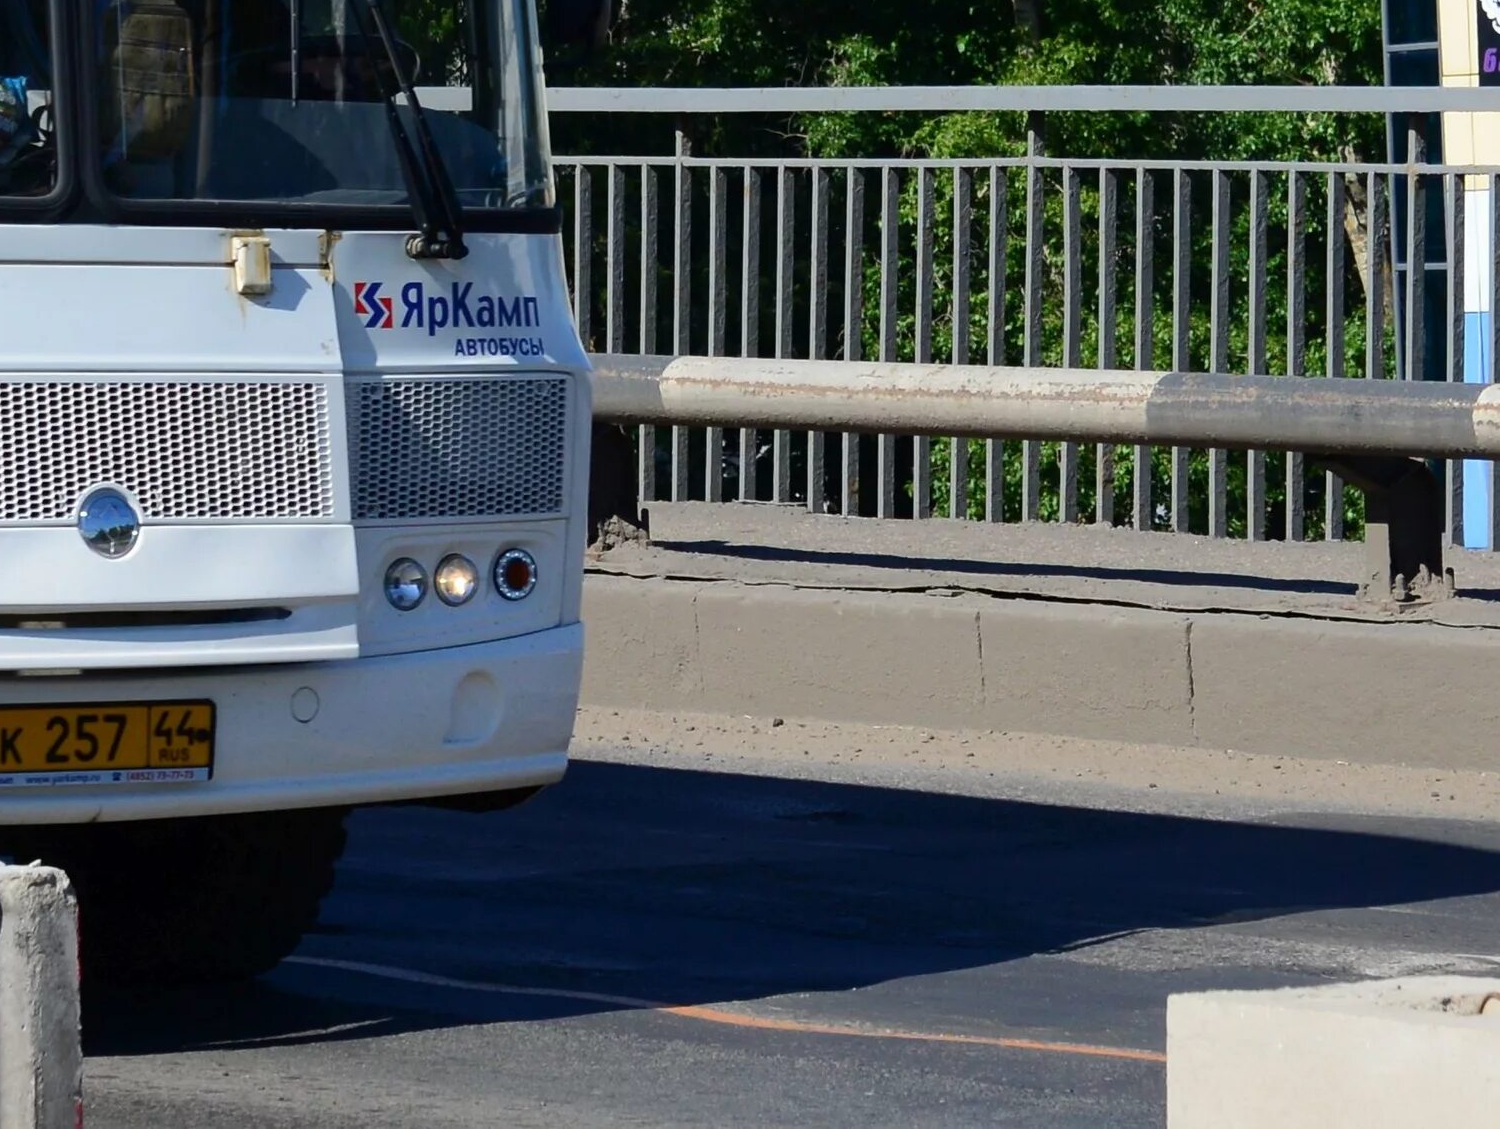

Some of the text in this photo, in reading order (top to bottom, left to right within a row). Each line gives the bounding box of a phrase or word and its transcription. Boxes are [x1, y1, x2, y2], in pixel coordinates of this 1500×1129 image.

[401, 282, 540, 336] ЯрКамп
[455, 338, 545, 356] АВТОБУСЫ
[46, 714, 127, 764] 257
[154, 710, 197, 747] 44
[158, 747, 190, 762] RUS
